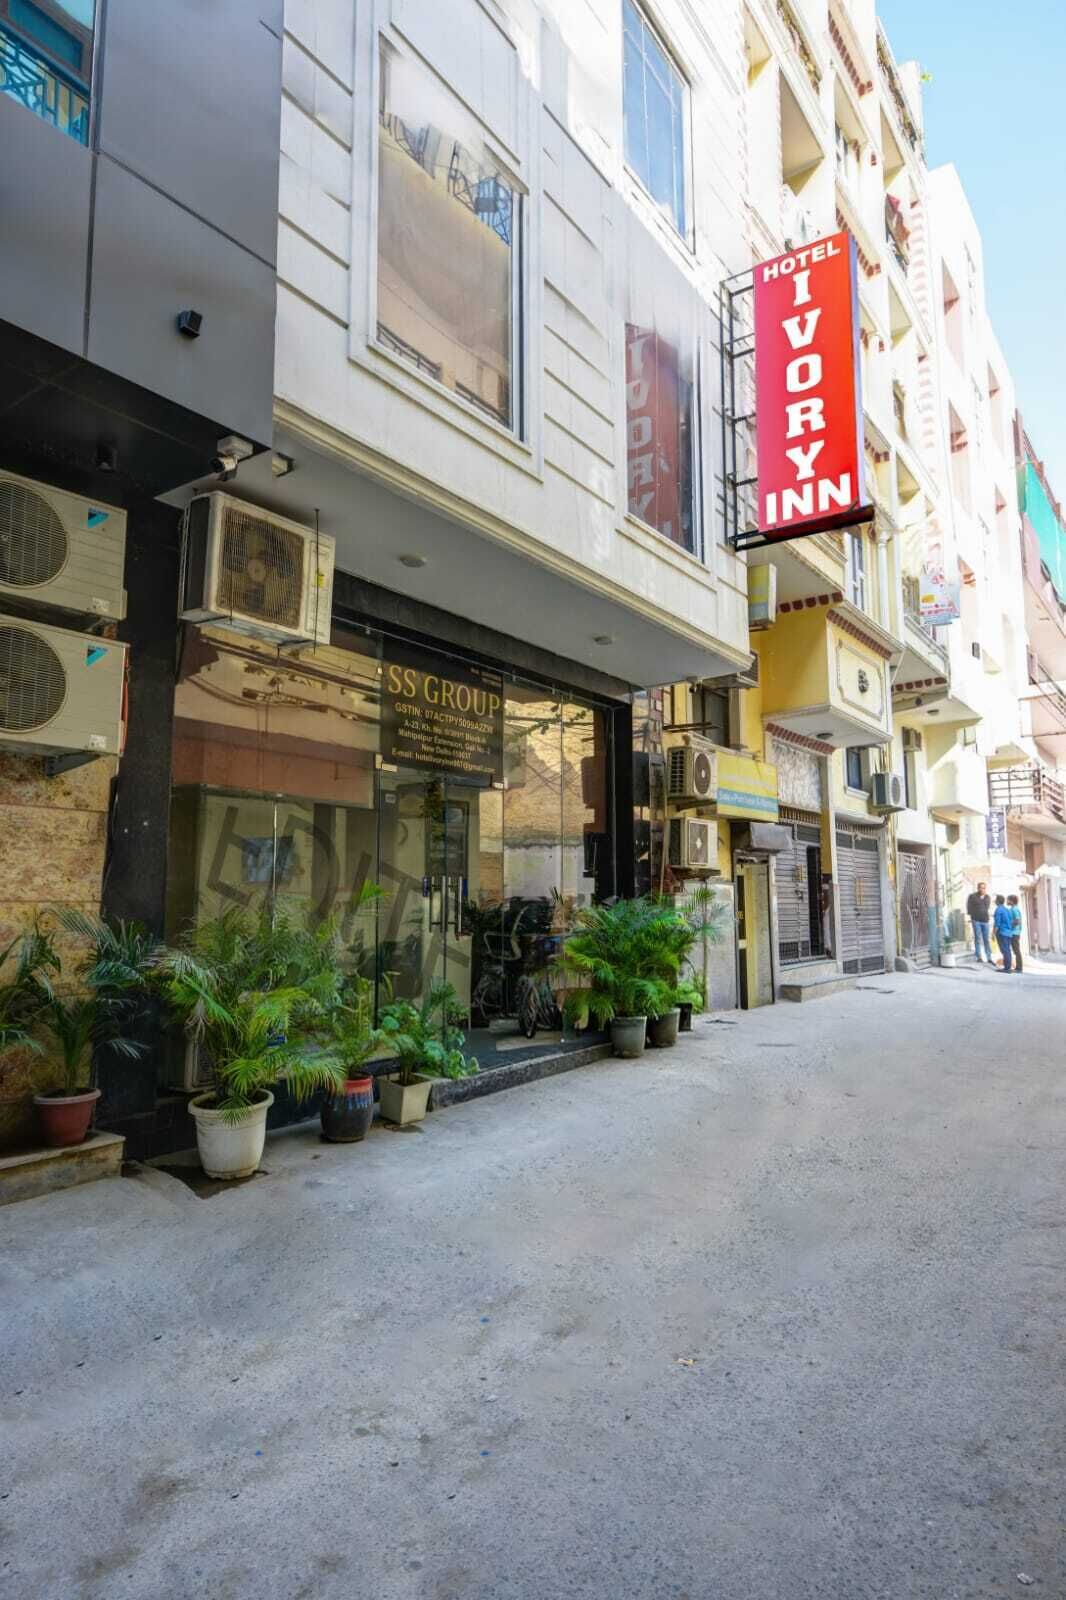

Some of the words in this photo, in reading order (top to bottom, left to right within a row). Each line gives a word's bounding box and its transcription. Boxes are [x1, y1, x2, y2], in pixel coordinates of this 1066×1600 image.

[763, 240, 841, 283] HOTEL
[781, 268, 827, 481] IVORY
[765, 471, 852, 525] INN
[388, 665, 416, 697] SS
[424, 675, 500, 718] GROUP
[395, 702, 423, 717] GSTIN:
